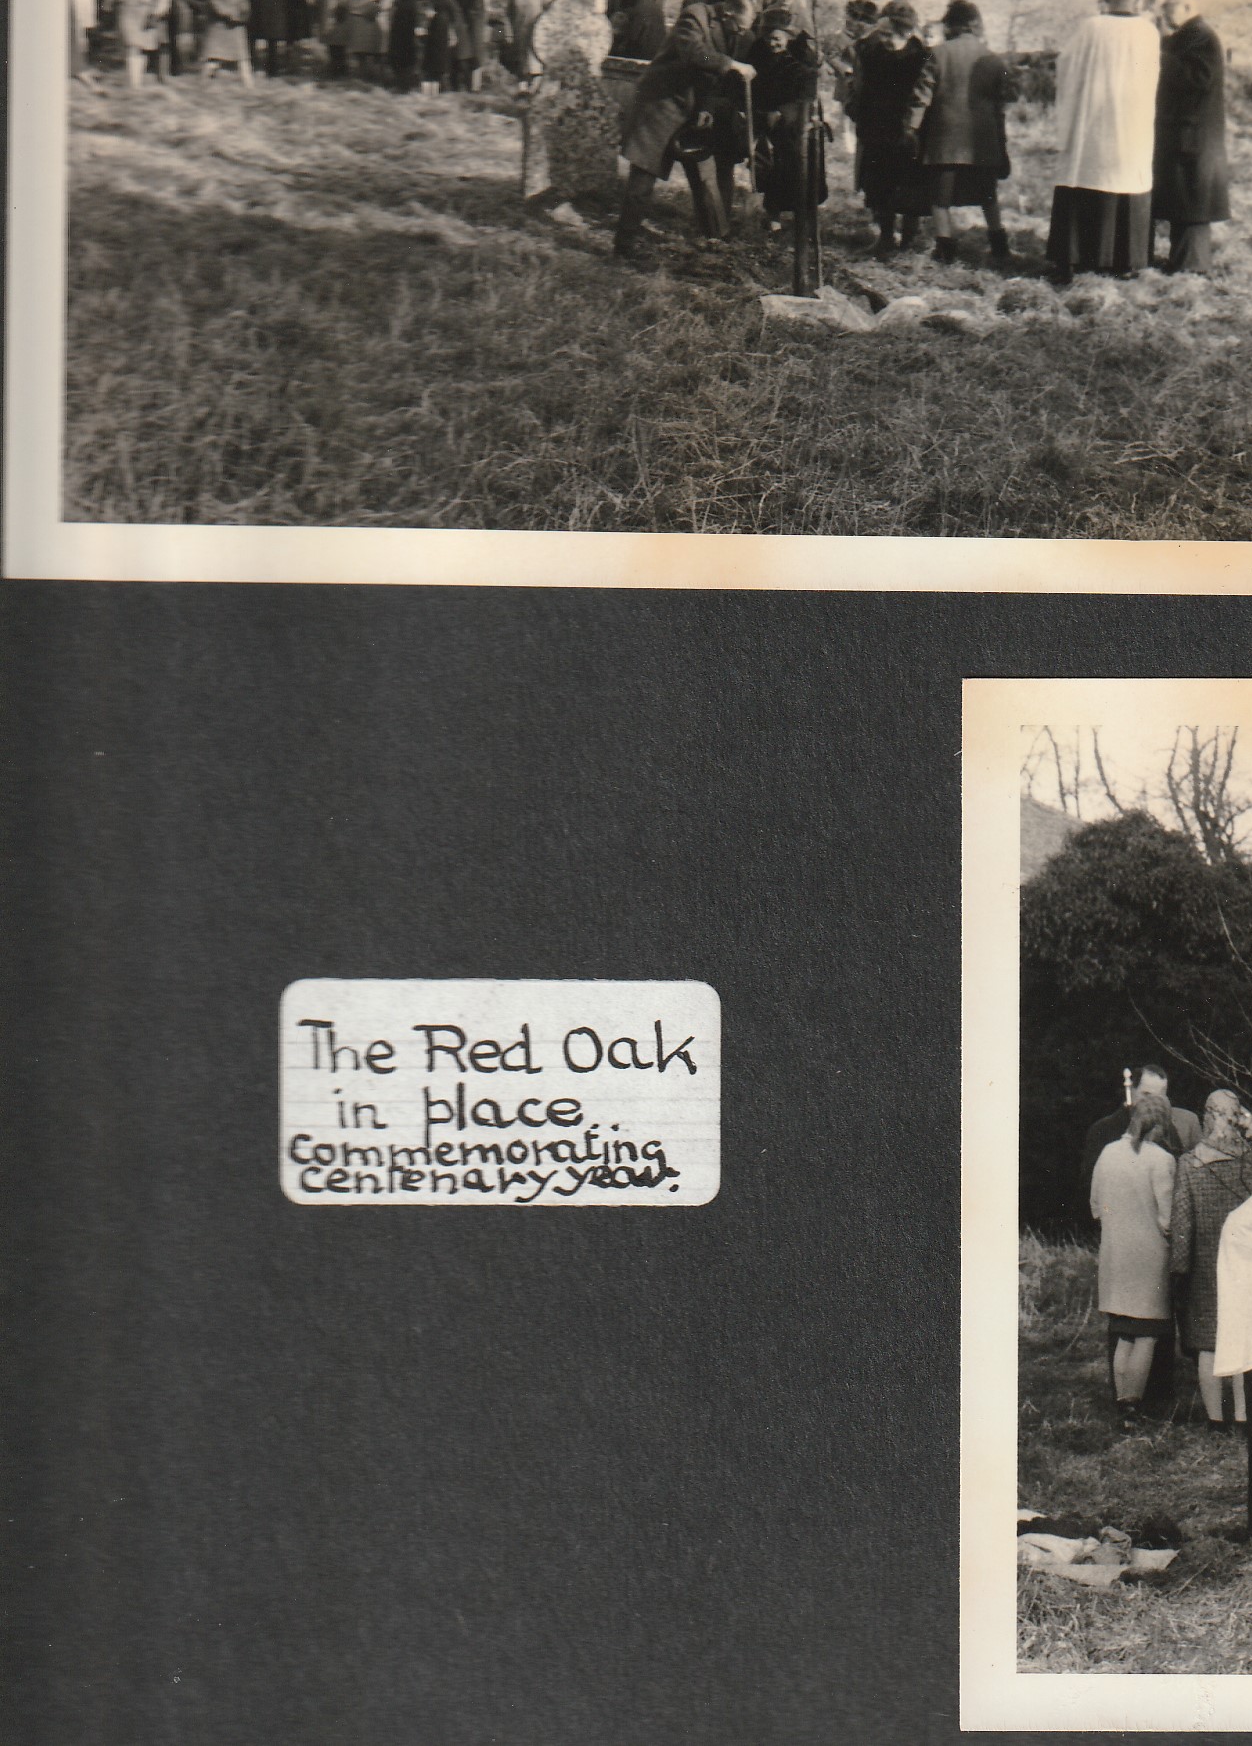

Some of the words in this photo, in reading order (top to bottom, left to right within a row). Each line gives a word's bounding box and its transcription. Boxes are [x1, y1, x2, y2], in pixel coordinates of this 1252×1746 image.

[298, 1018, 396, 1075] The
[412, 1022, 543, 1075] Red
[563, 1019, 698, 1076] Oak
[333, 1087, 388, 1130] in
[424, 1081, 584, 1147] place
